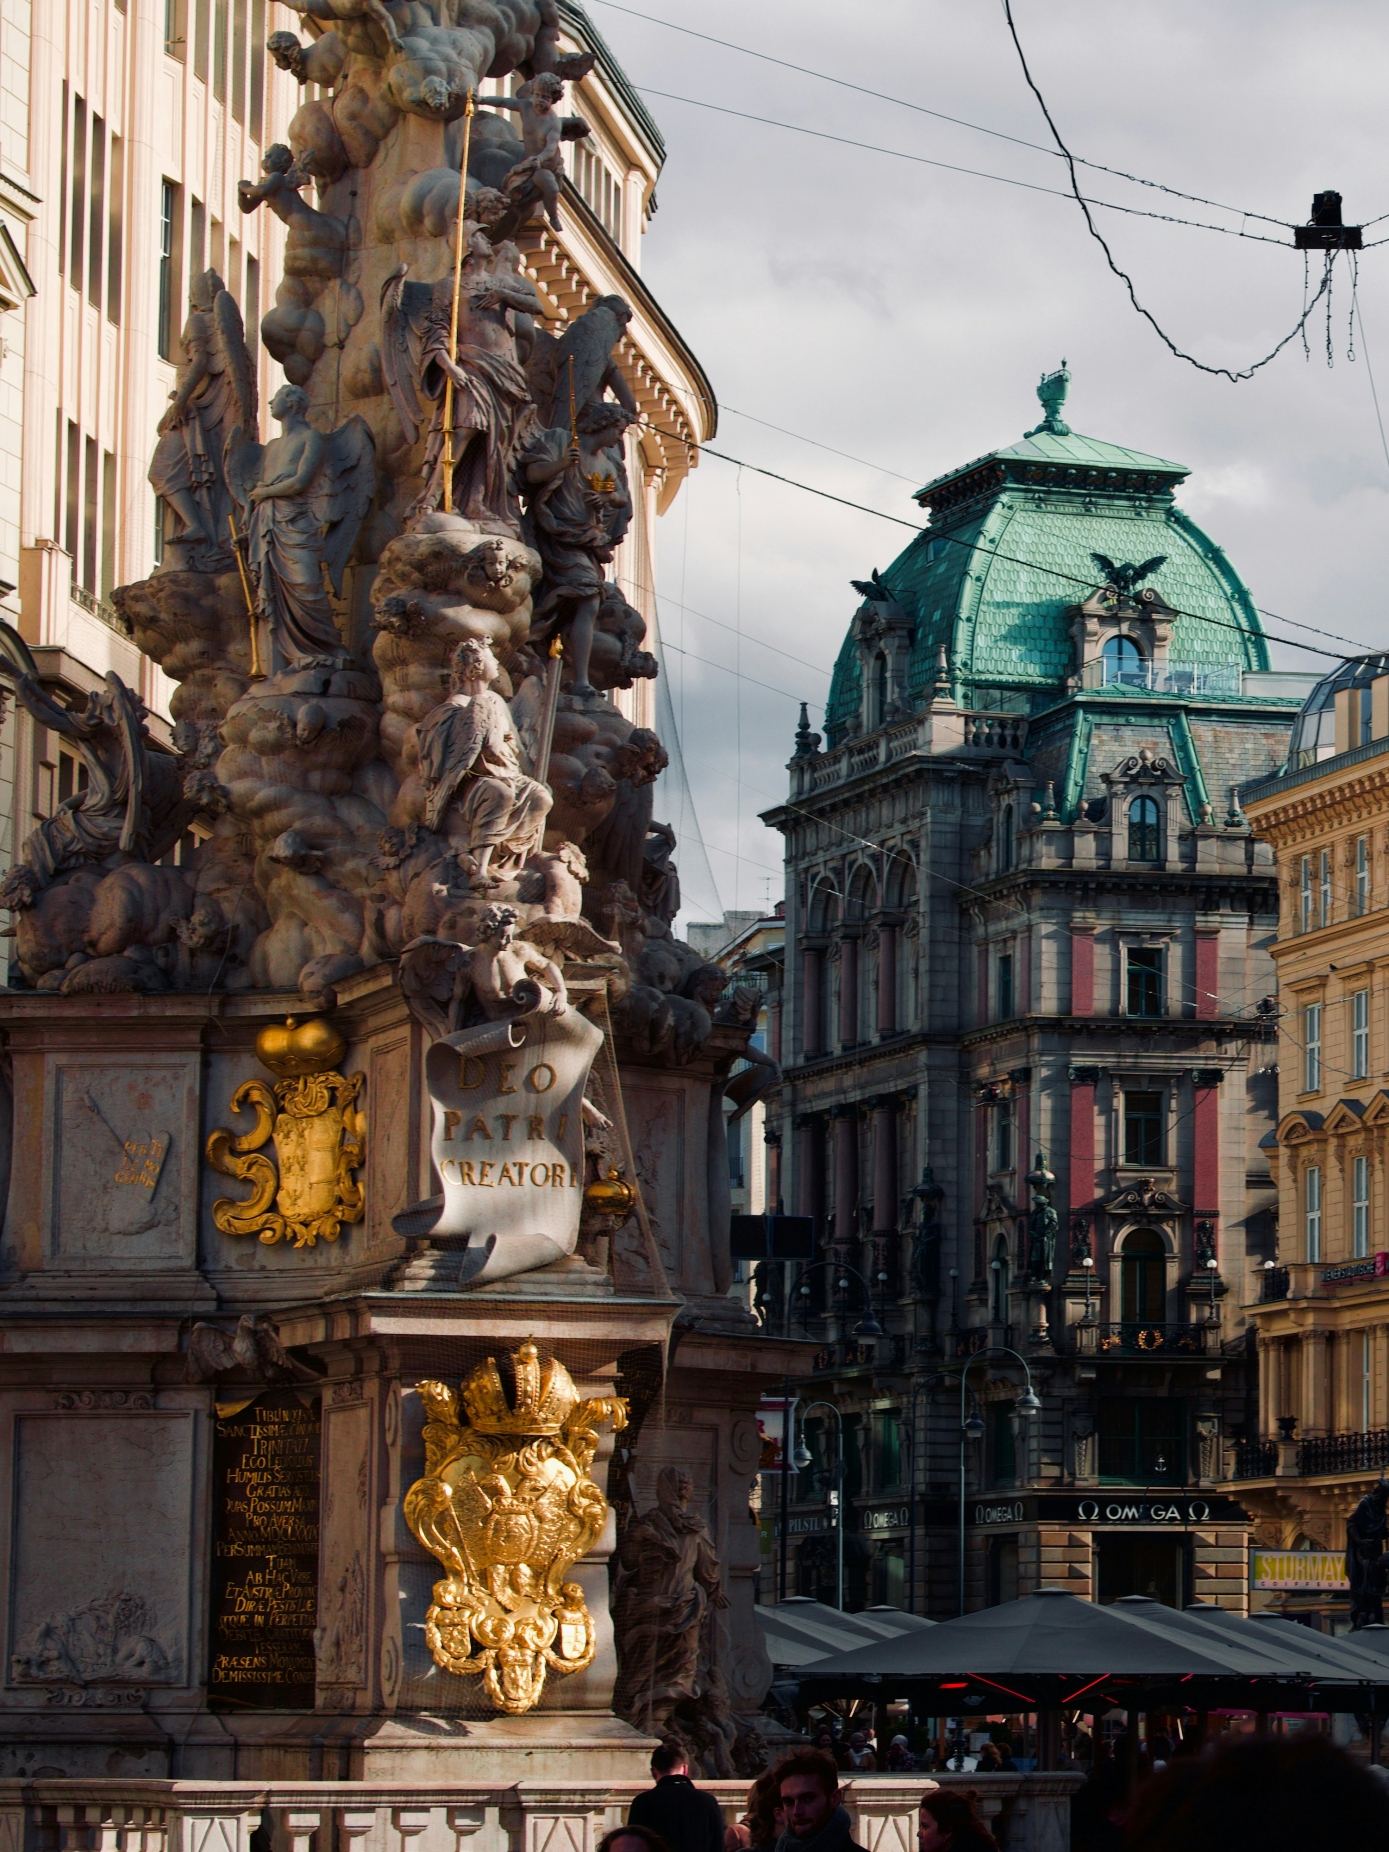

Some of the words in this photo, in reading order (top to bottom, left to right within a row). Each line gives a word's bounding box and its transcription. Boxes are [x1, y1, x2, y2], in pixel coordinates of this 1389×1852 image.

[458, 1055, 557, 1093] DEO
[443, 1109, 567, 1141] PATRI
[440, 1159, 577, 1187] CREATORI
[873, 1511, 899, 1528] OMEGA
[984, 1507, 1013, 1523] OMEGA
